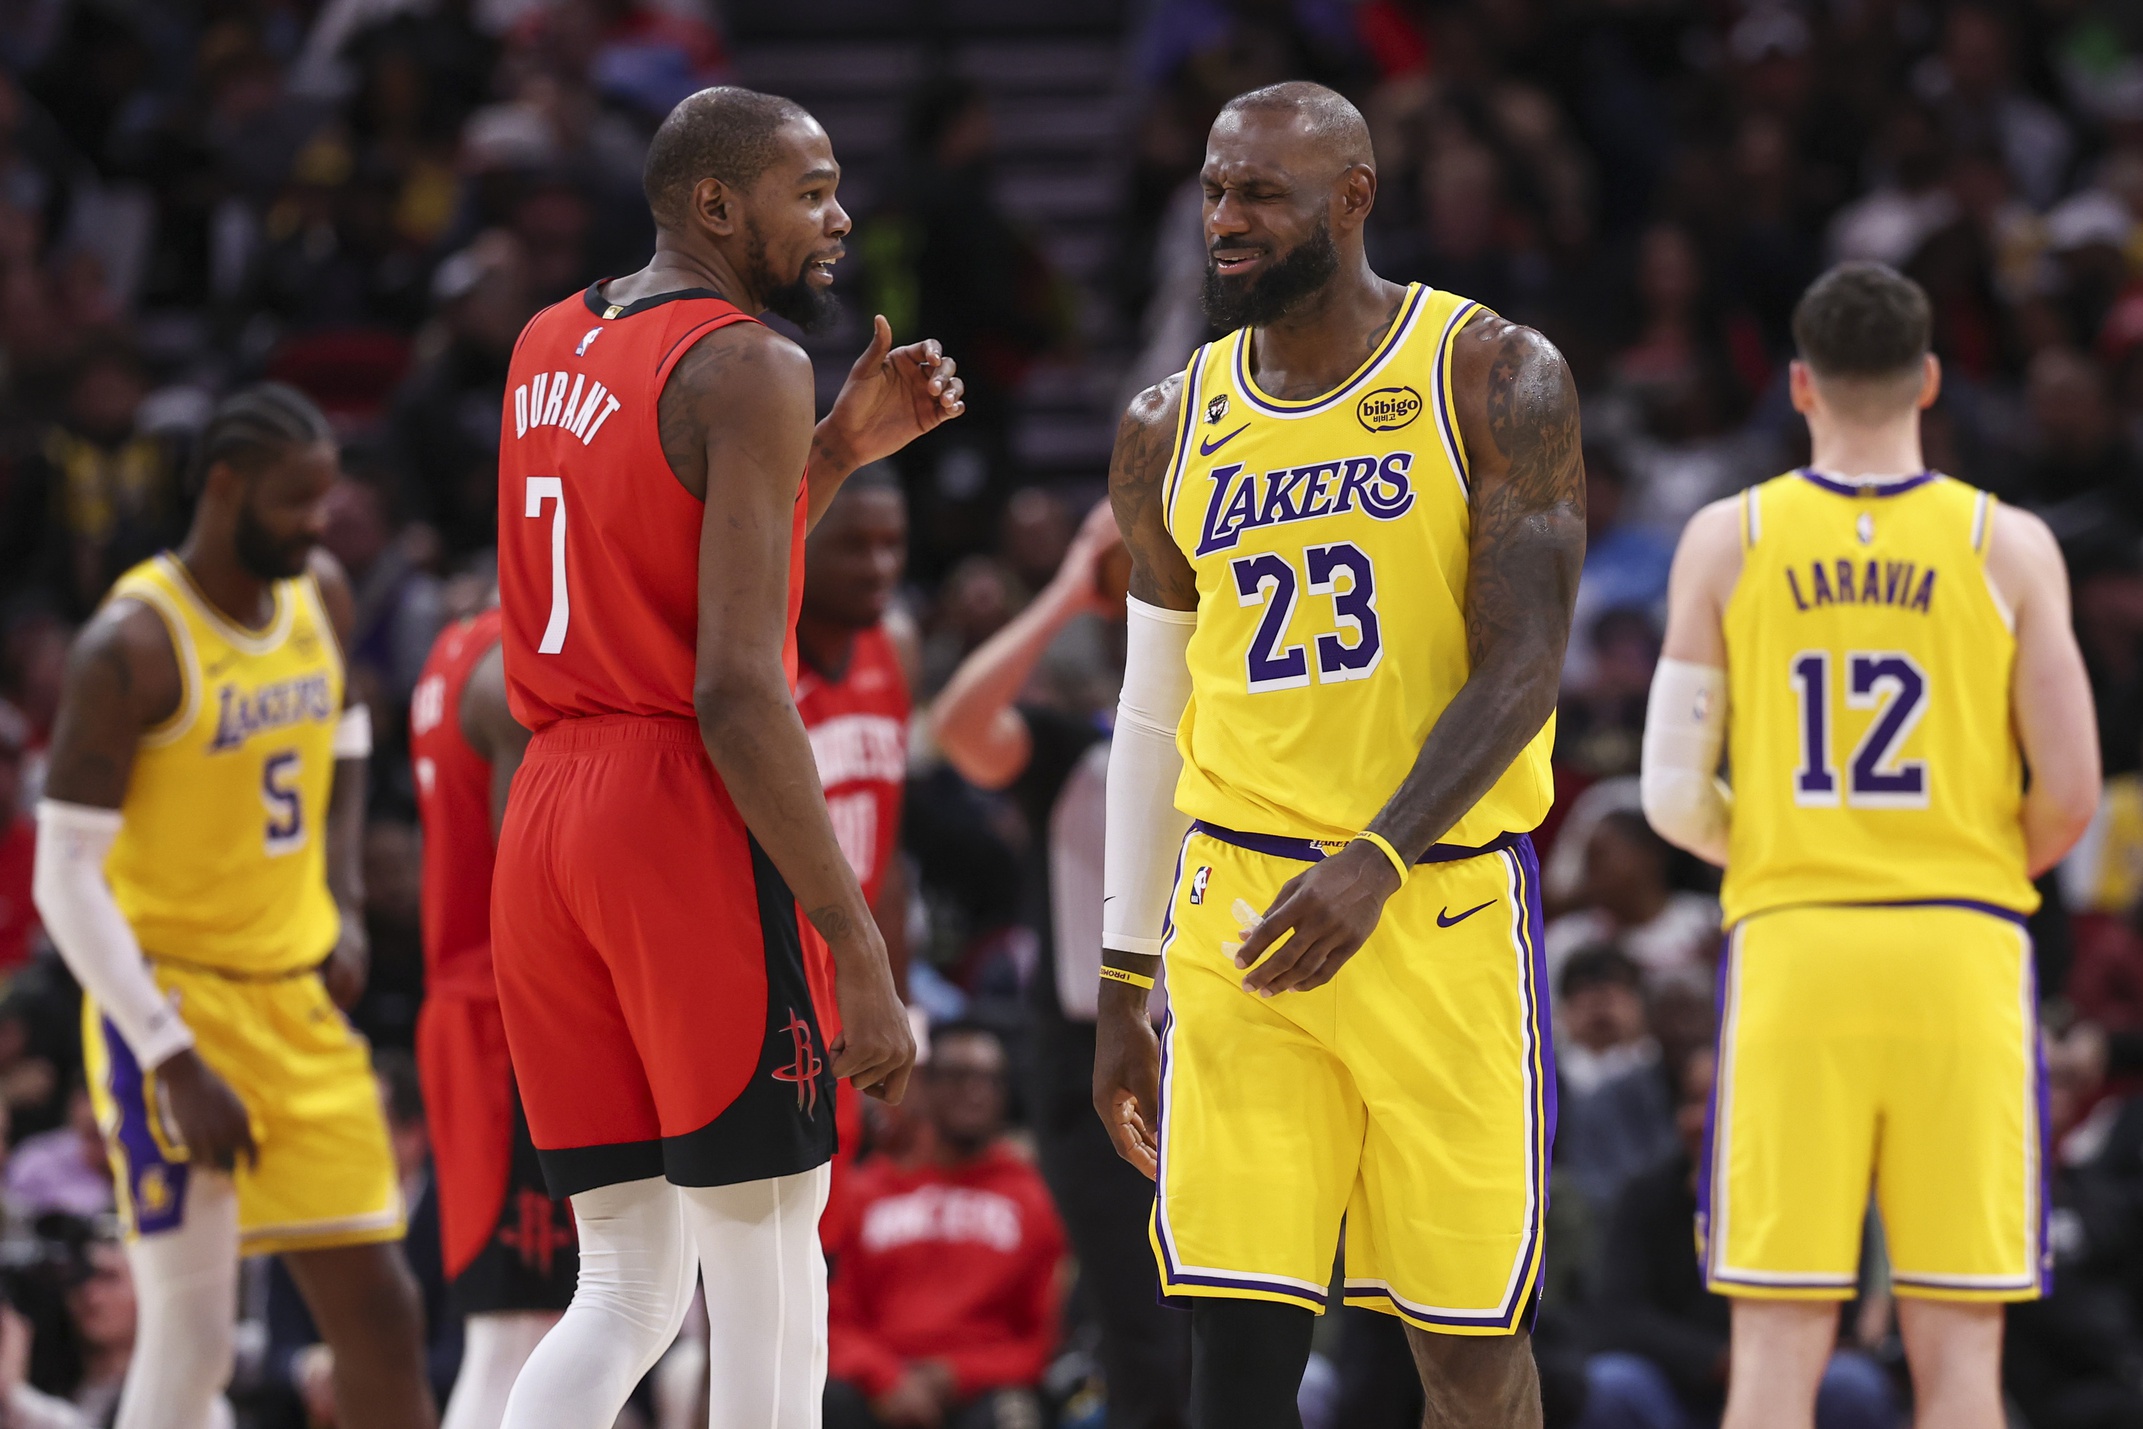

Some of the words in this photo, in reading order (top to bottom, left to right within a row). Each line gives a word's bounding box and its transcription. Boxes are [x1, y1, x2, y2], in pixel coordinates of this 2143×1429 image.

[515, 371, 621, 446] DURANT
[1363, 398, 1418, 416] bibigo
[1194, 450, 1418, 560] LAKERS
[525, 477, 570, 654] 7
[1229, 540, 1384, 694] 23
[1785, 558, 1936, 615] LARAVIA
[1790, 650, 1931, 808] 12
[263, 750, 305, 857] 5
